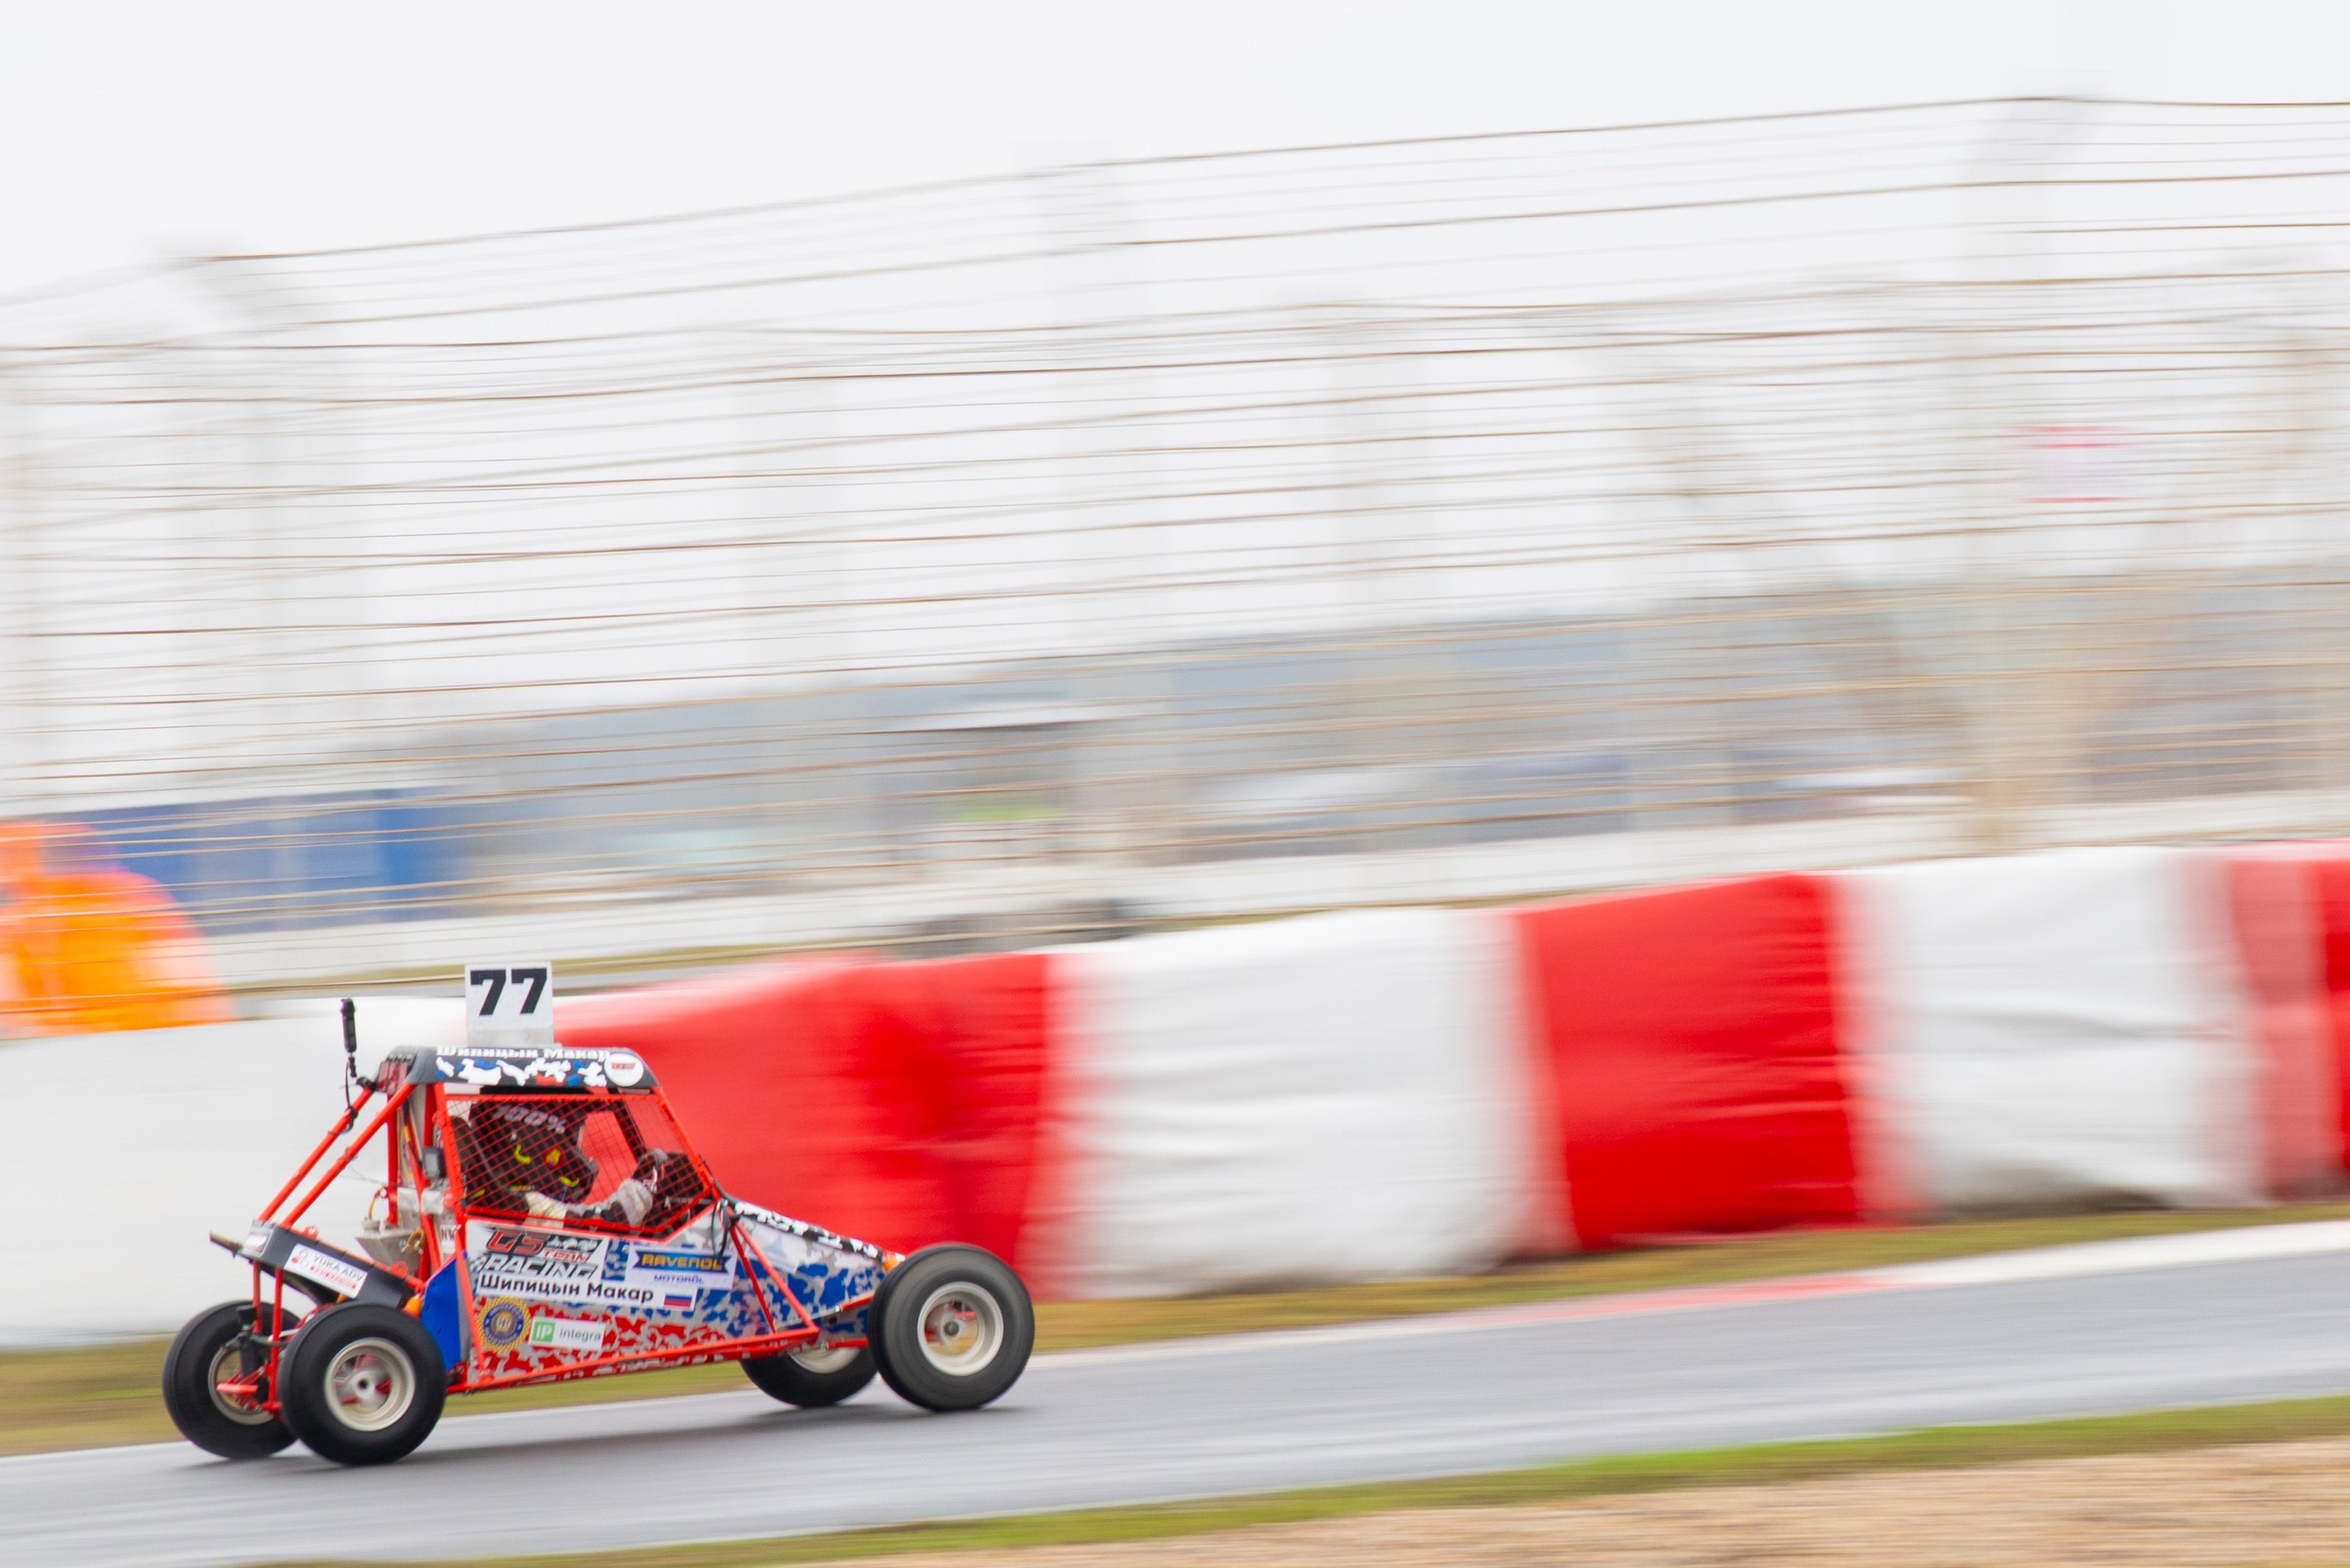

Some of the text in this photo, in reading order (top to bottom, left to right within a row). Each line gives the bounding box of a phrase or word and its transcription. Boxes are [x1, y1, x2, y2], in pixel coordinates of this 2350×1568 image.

[470, 969, 548, 1016] 77
[437, 1047, 610, 1061] Шипицын Макар
[543, 1249, 590, 1263] TEAM
[642, 1253, 722, 1271] RAVENOL
[483, 1254, 598, 1279] RACING
[481, 1274, 654, 1304] Шипицын Макар
[536, 1324, 553, 1339] IP
